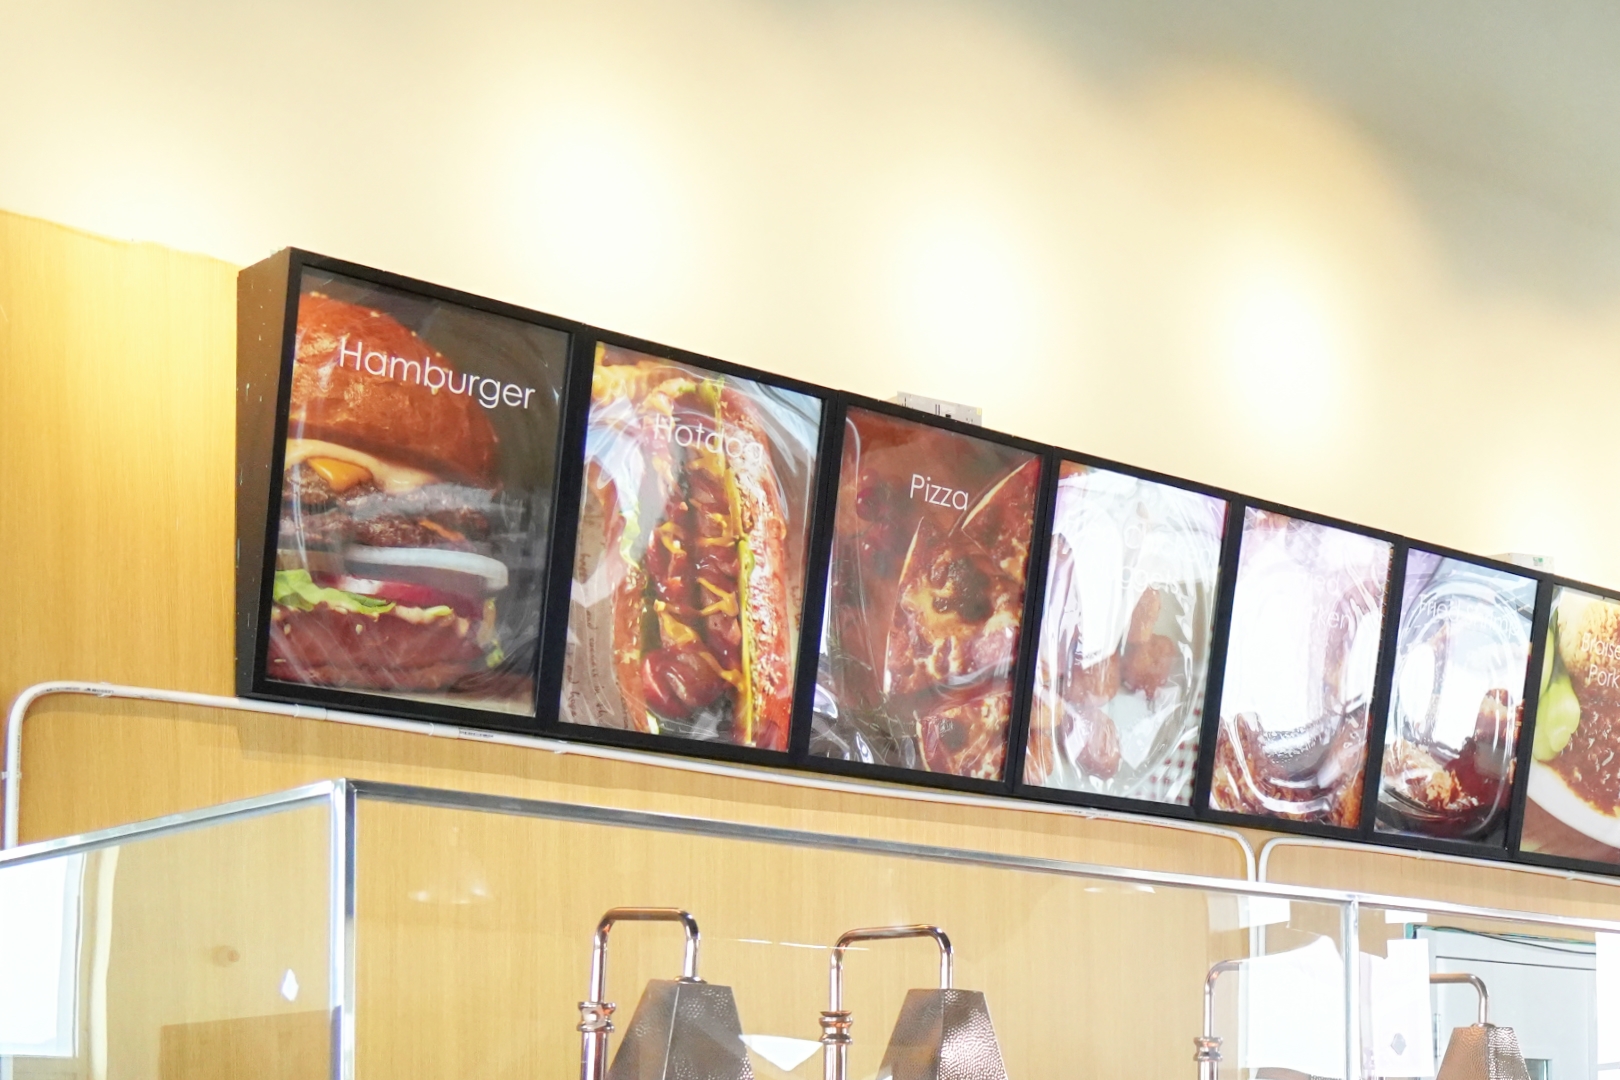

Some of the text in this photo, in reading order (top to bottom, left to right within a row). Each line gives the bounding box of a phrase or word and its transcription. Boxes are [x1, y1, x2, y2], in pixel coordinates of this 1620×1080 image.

[339, 336, 536, 410] Hamburger
[653, 413, 764, 467] Hotdog
[909, 473, 969, 511] Pizza
[1588, 664, 1620, 689] Pork
